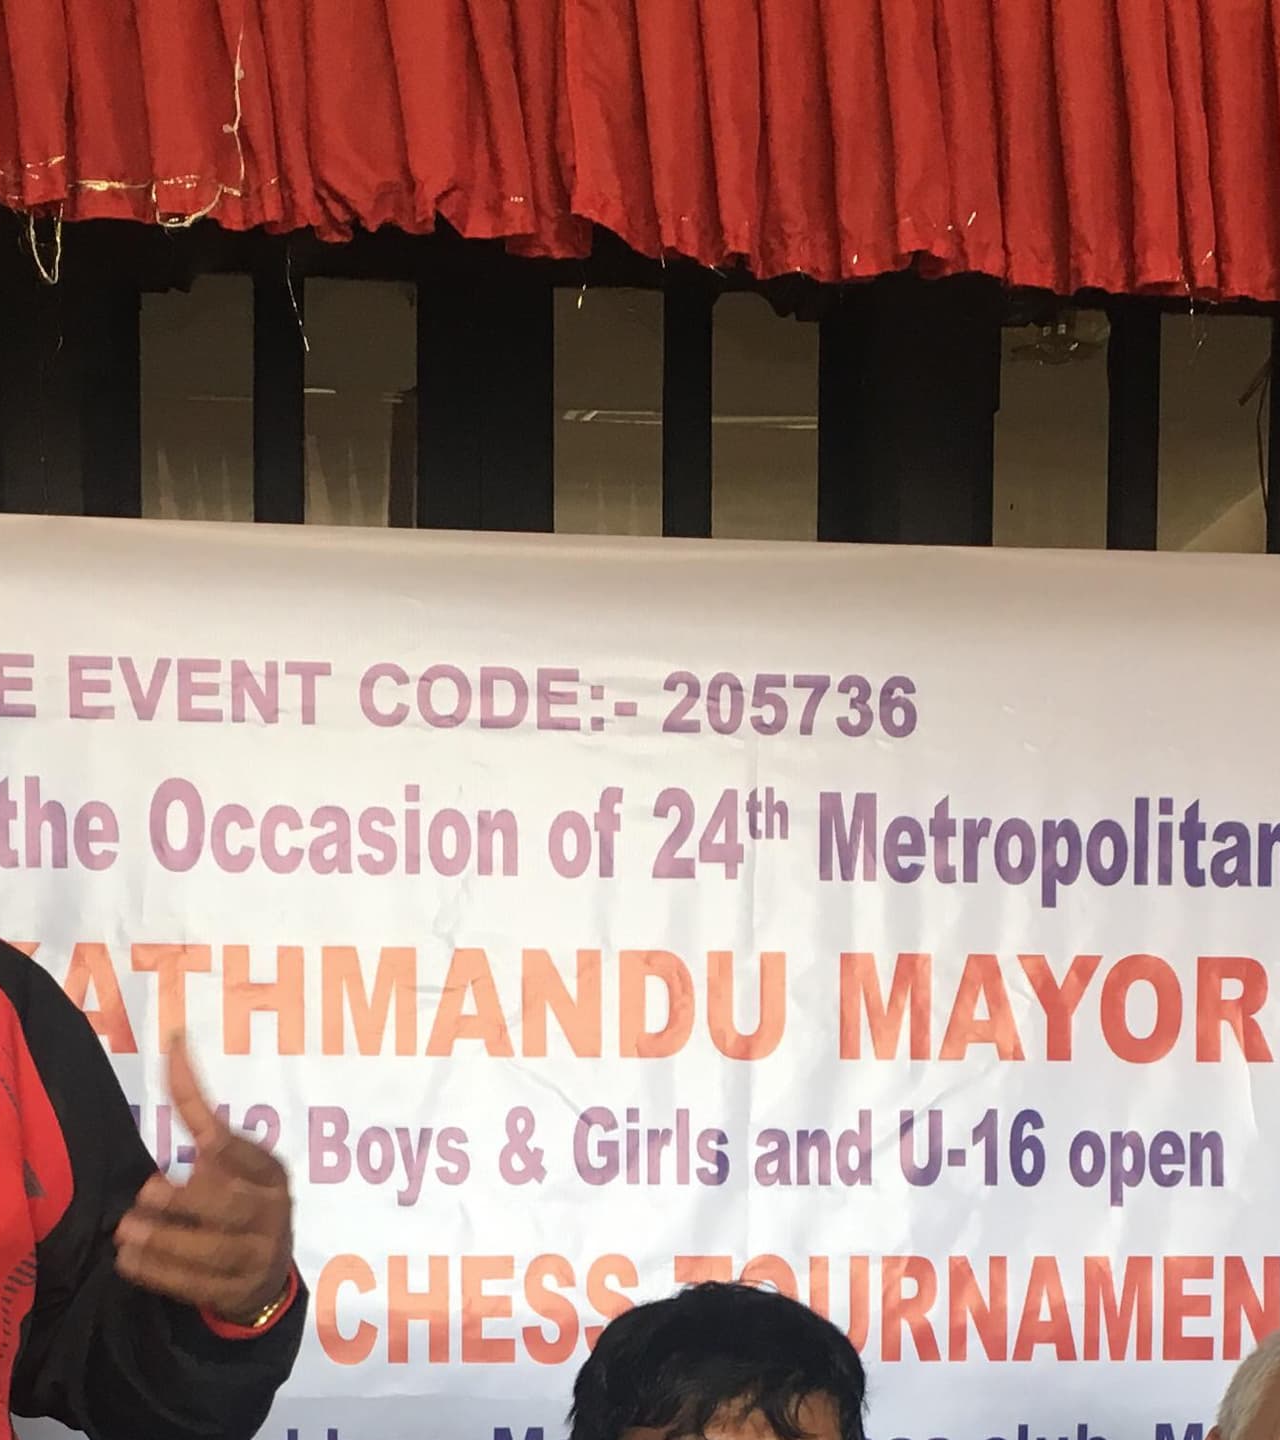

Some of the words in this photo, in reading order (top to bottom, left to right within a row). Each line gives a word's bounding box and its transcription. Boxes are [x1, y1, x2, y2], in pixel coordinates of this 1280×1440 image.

[68, 655, 332, 727] EVENT
[359, 661, 638, 734] CODE:-
[661, 670, 918, 738] 205736
[149, 777, 520, 877] Occasion
[548, 786, 624, 880] of
[651, 786, 790, 881] 24th
[16, 941, 787, 1060] ATHMANDU
[838, 951, 1275, 1065] MAYOR
[129, 1103, 281, 1175] U-2
[307, 1105, 470, 1207] Boys
[498, 1106, 547, 1185] &
[572, 1106, 730, 1187] Girls
[753, 1108, 873, 1187] and
[898, 1107, 1047, 1188] U-16
[1068, 1130, 1225, 1207] open
[317, 1252, 640, 1364] CHESS
